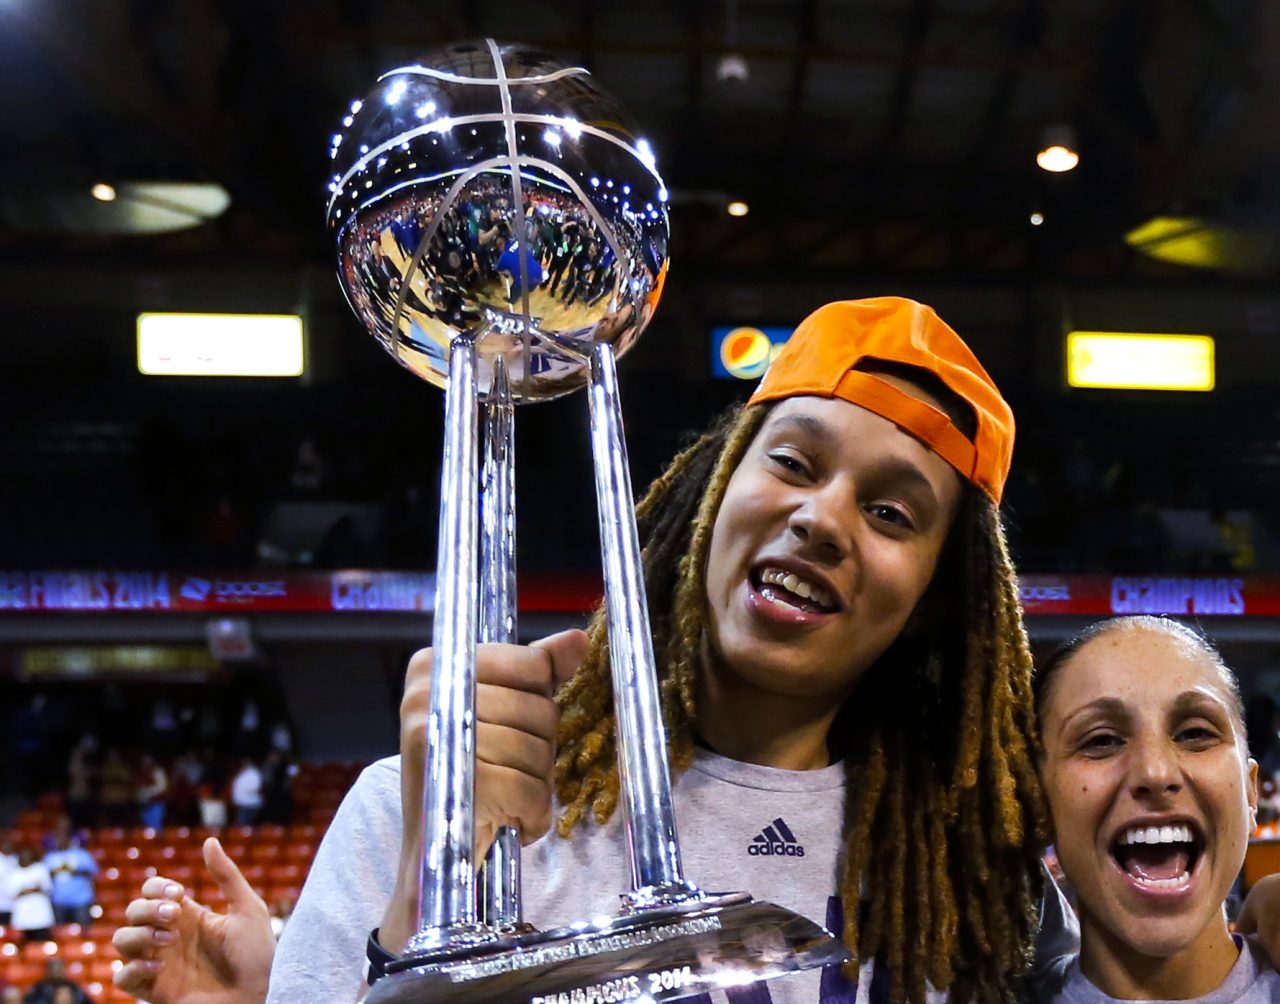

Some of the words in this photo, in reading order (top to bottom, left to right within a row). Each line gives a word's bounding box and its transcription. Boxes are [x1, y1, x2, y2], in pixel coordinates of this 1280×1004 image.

[331, 570, 436, 611] CHAMPI
[1111, 577, 1245, 615] CHAMPIONS
[747, 841, 805, 857] adidas
[648, 966, 691, 994] 2014
